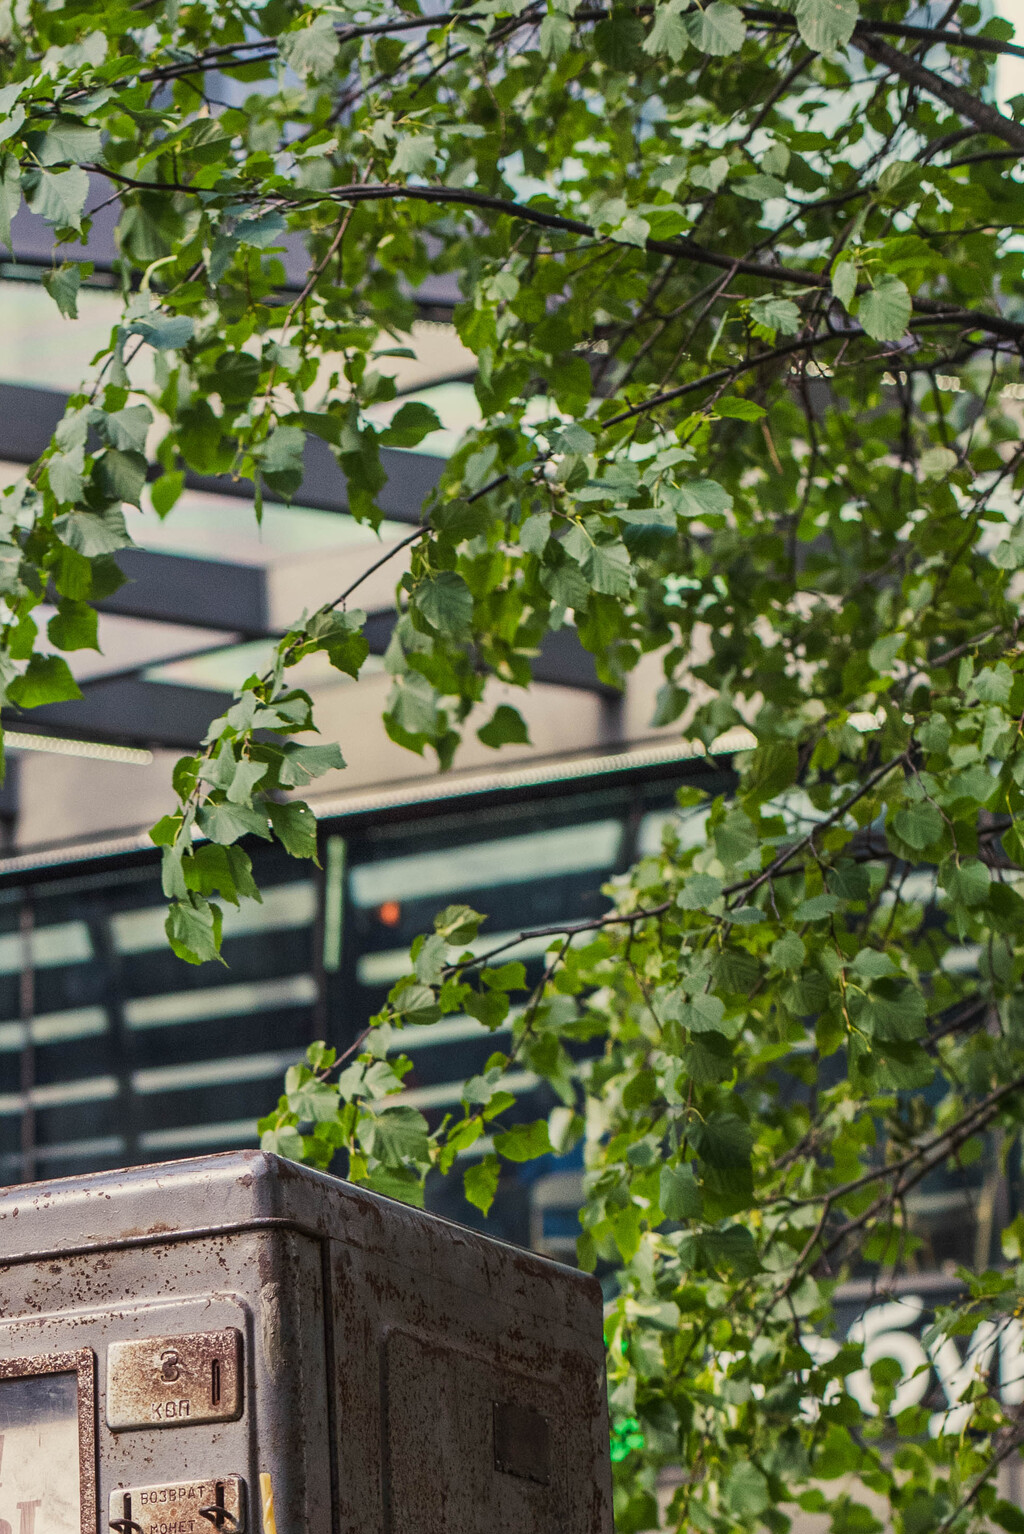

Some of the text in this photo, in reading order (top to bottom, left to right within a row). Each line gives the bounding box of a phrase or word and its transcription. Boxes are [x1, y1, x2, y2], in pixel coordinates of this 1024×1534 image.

[160, 1350, 179, 1384] 3
[151, 1399, 190, 1418] КОП
[140, 1485, 206, 1505] ВОЗВРАТ
